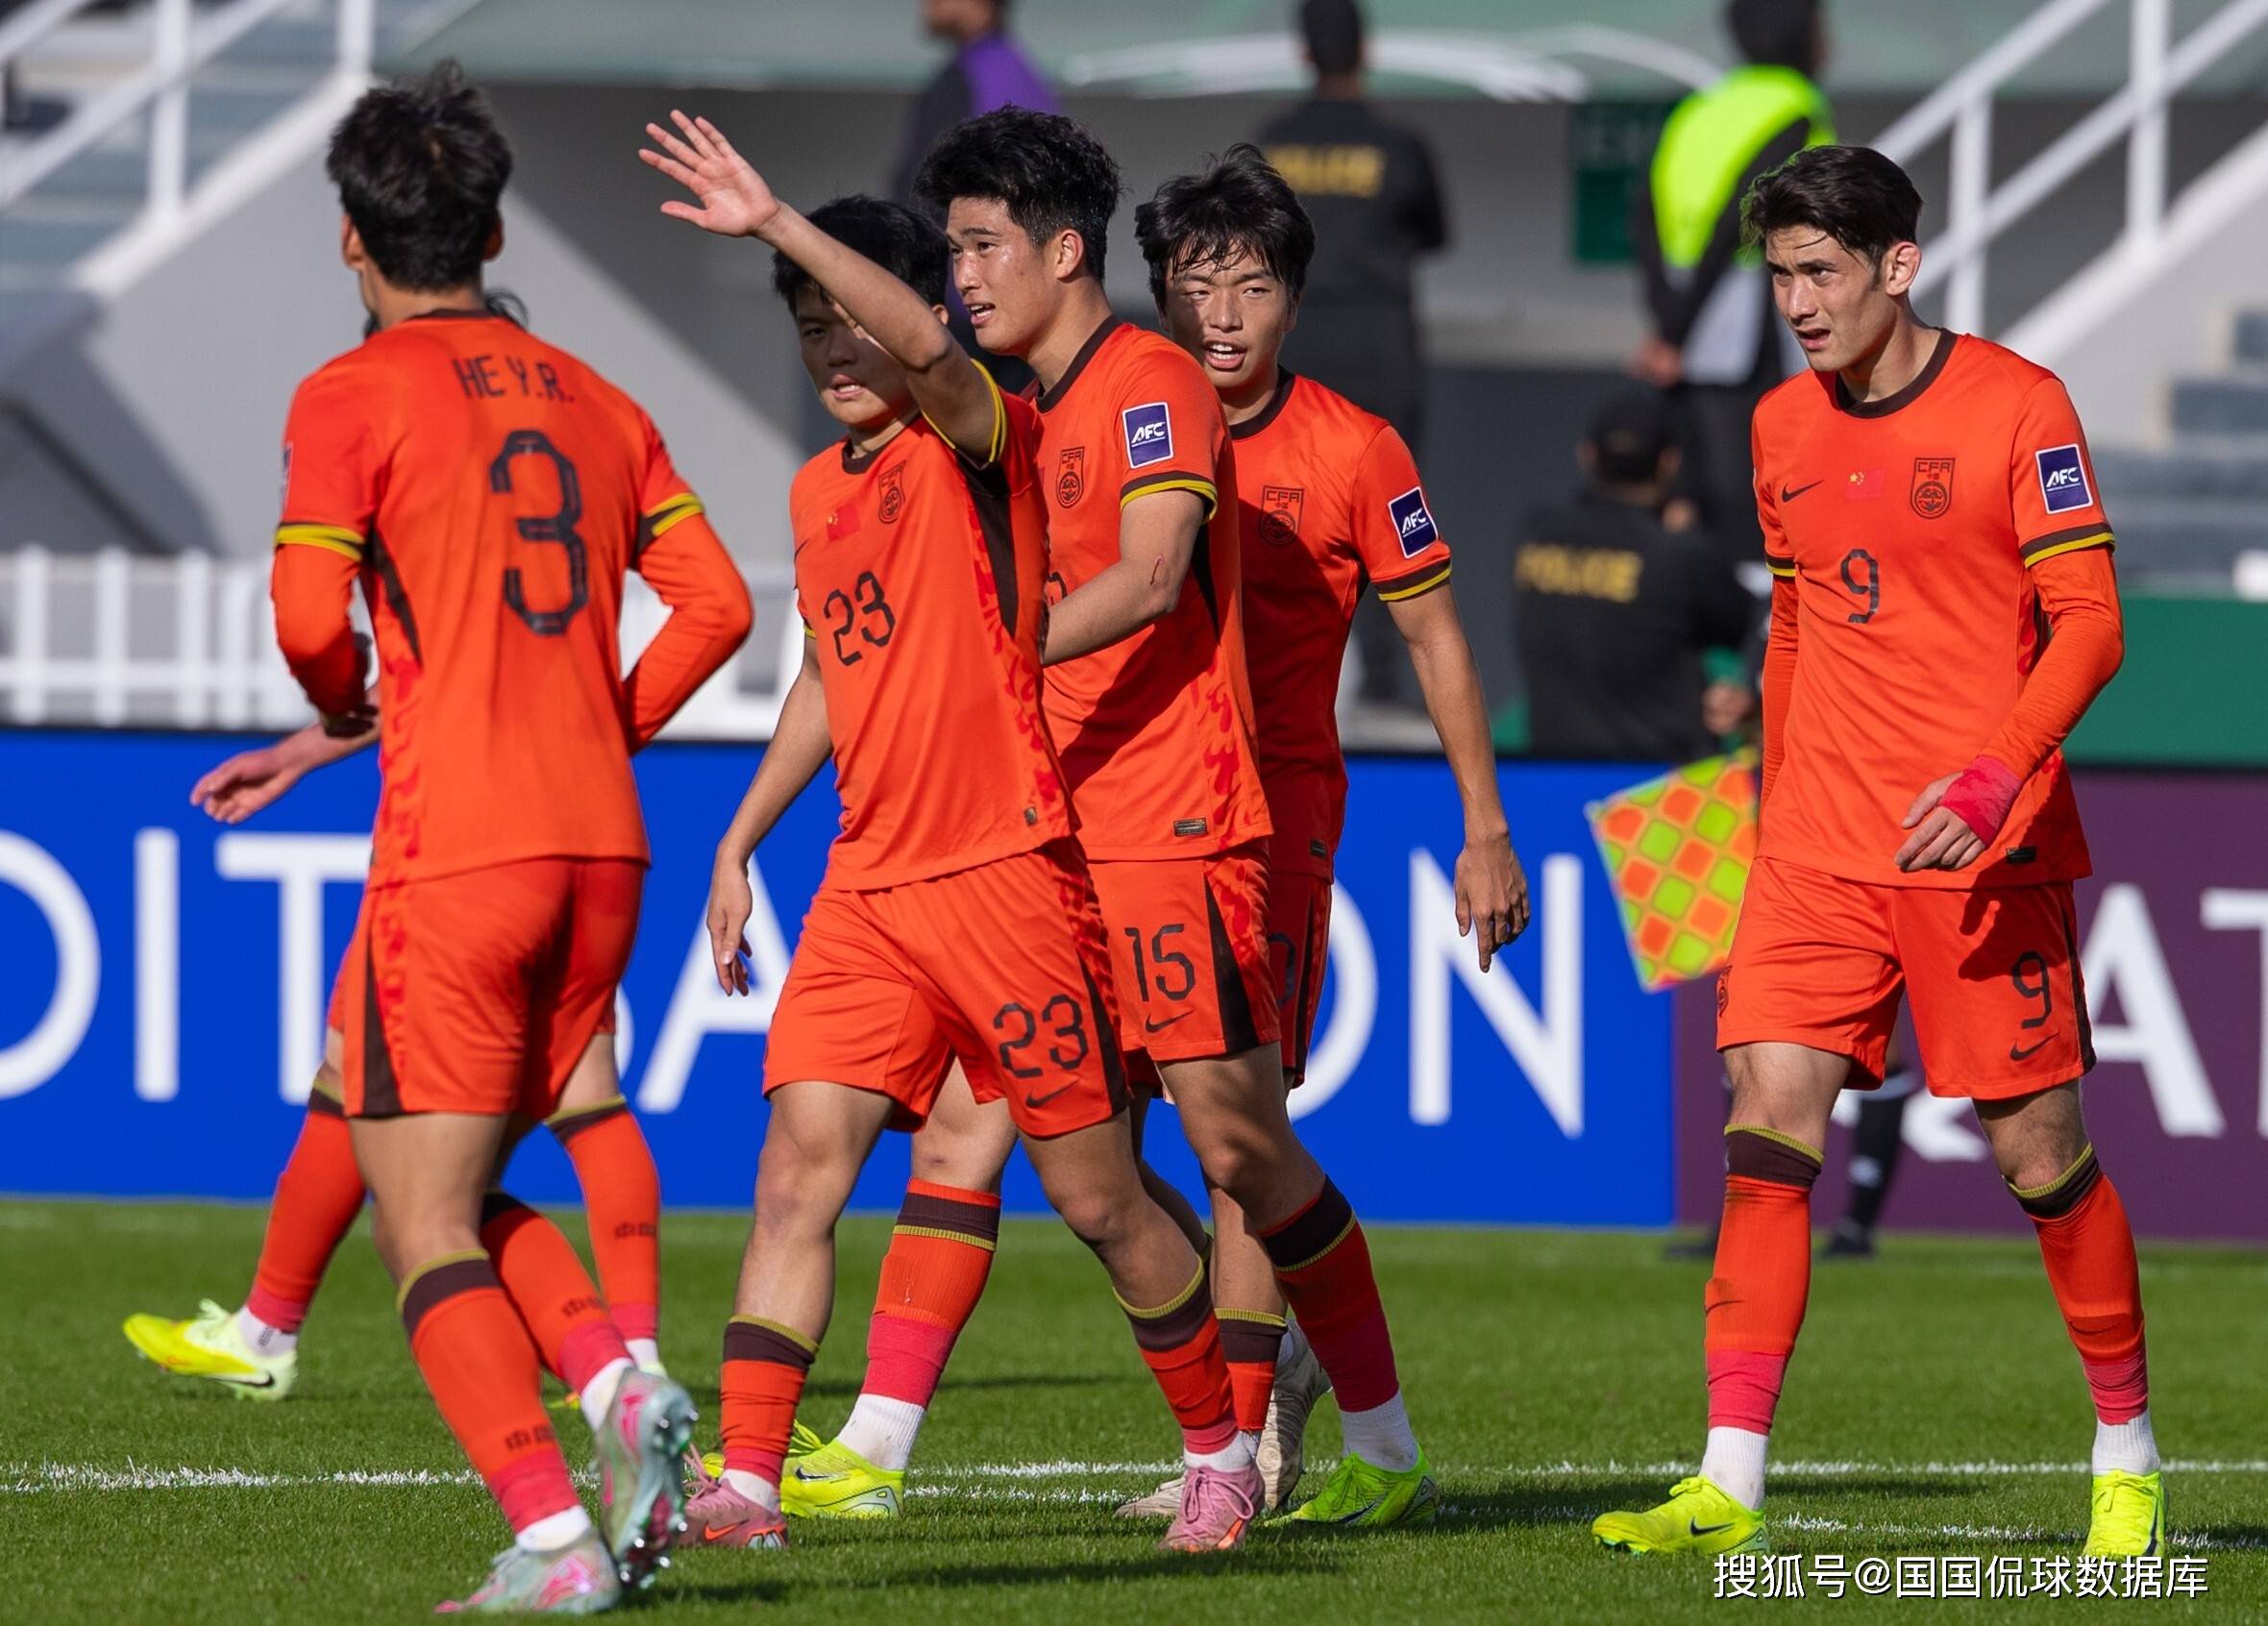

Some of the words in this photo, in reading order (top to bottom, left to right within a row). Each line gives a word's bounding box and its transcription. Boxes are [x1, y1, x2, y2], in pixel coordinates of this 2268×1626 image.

[452, 355, 505, 399] HE
[1131, 421, 1166, 444] AFC
[1917, 461, 1951, 473] CFA
[2045, 466, 2080, 488] AFC
[1266, 490, 1300, 504] CFA
[1401, 507, 1427, 534] AFC
[488, 430, 589, 637] 3
[1839, 549, 1880, 624] 9
[824, 570, 897, 667] 23
[1123, 924, 1196, 1003] 15
[2011, 948, 2053, 1029] 9
[993, 994, 1090, 1079] 23
